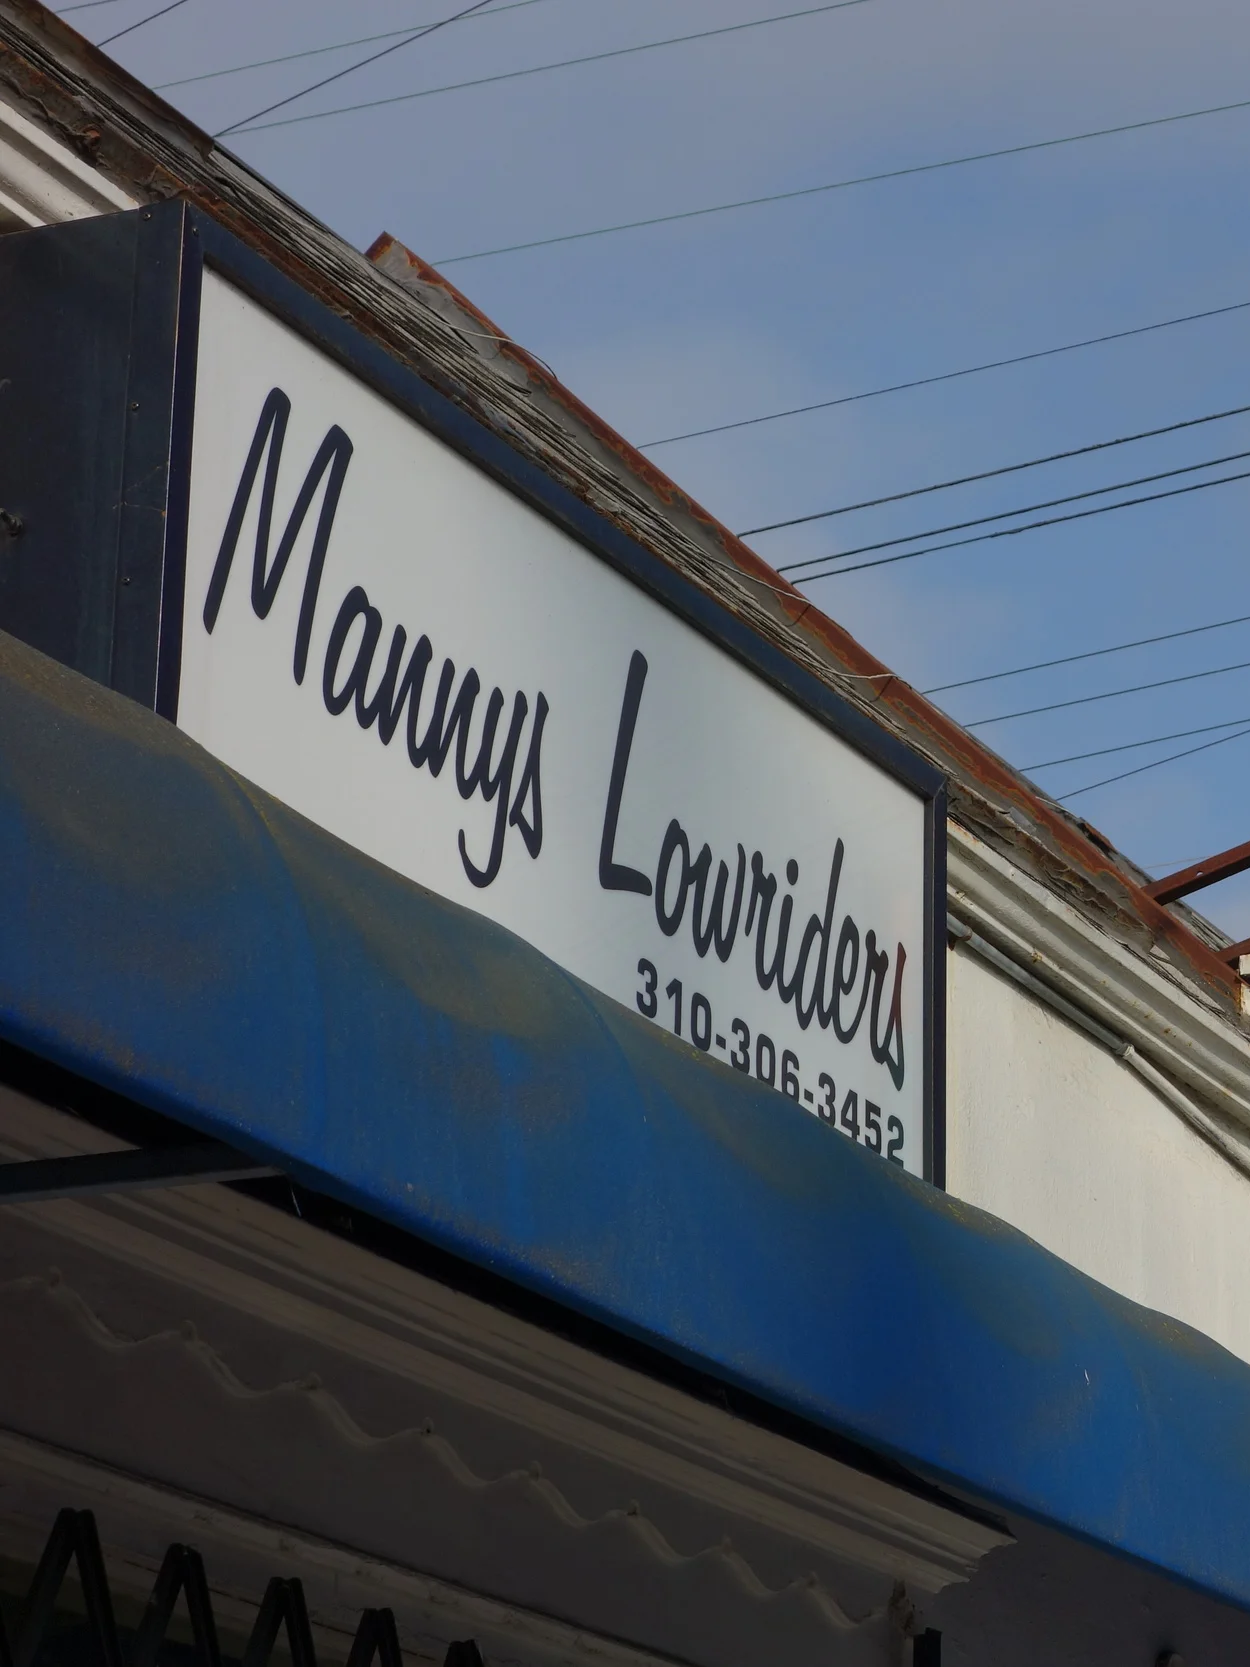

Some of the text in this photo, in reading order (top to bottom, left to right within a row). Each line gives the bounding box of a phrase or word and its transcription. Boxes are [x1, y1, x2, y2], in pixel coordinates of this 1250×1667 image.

[203, 387, 907, 1091] Mannys Lowriders
[636, 957, 904, 1169] 310-306-3452
